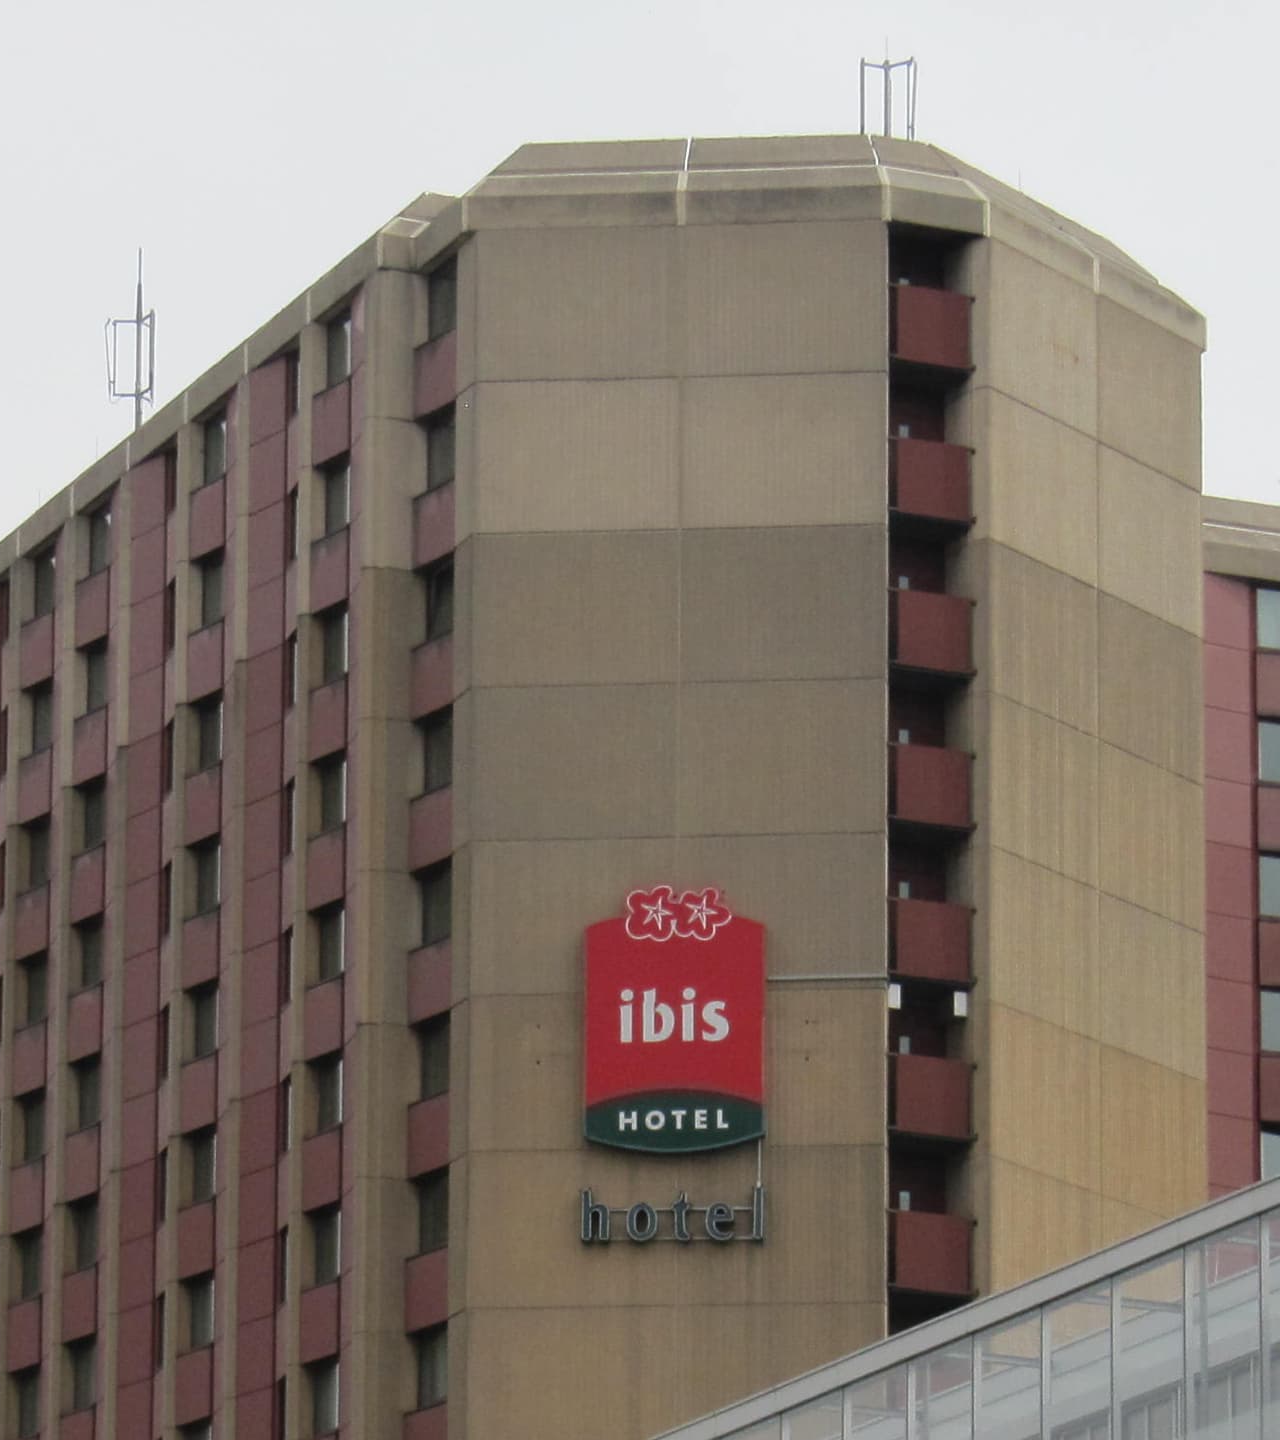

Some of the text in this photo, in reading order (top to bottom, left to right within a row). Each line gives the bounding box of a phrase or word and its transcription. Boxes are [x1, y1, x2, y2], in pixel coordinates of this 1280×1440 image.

[620, 987, 729, 1043] ibis
[619, 1109, 729, 1131] HOTEL
[580, 1186, 765, 1242] hotel
